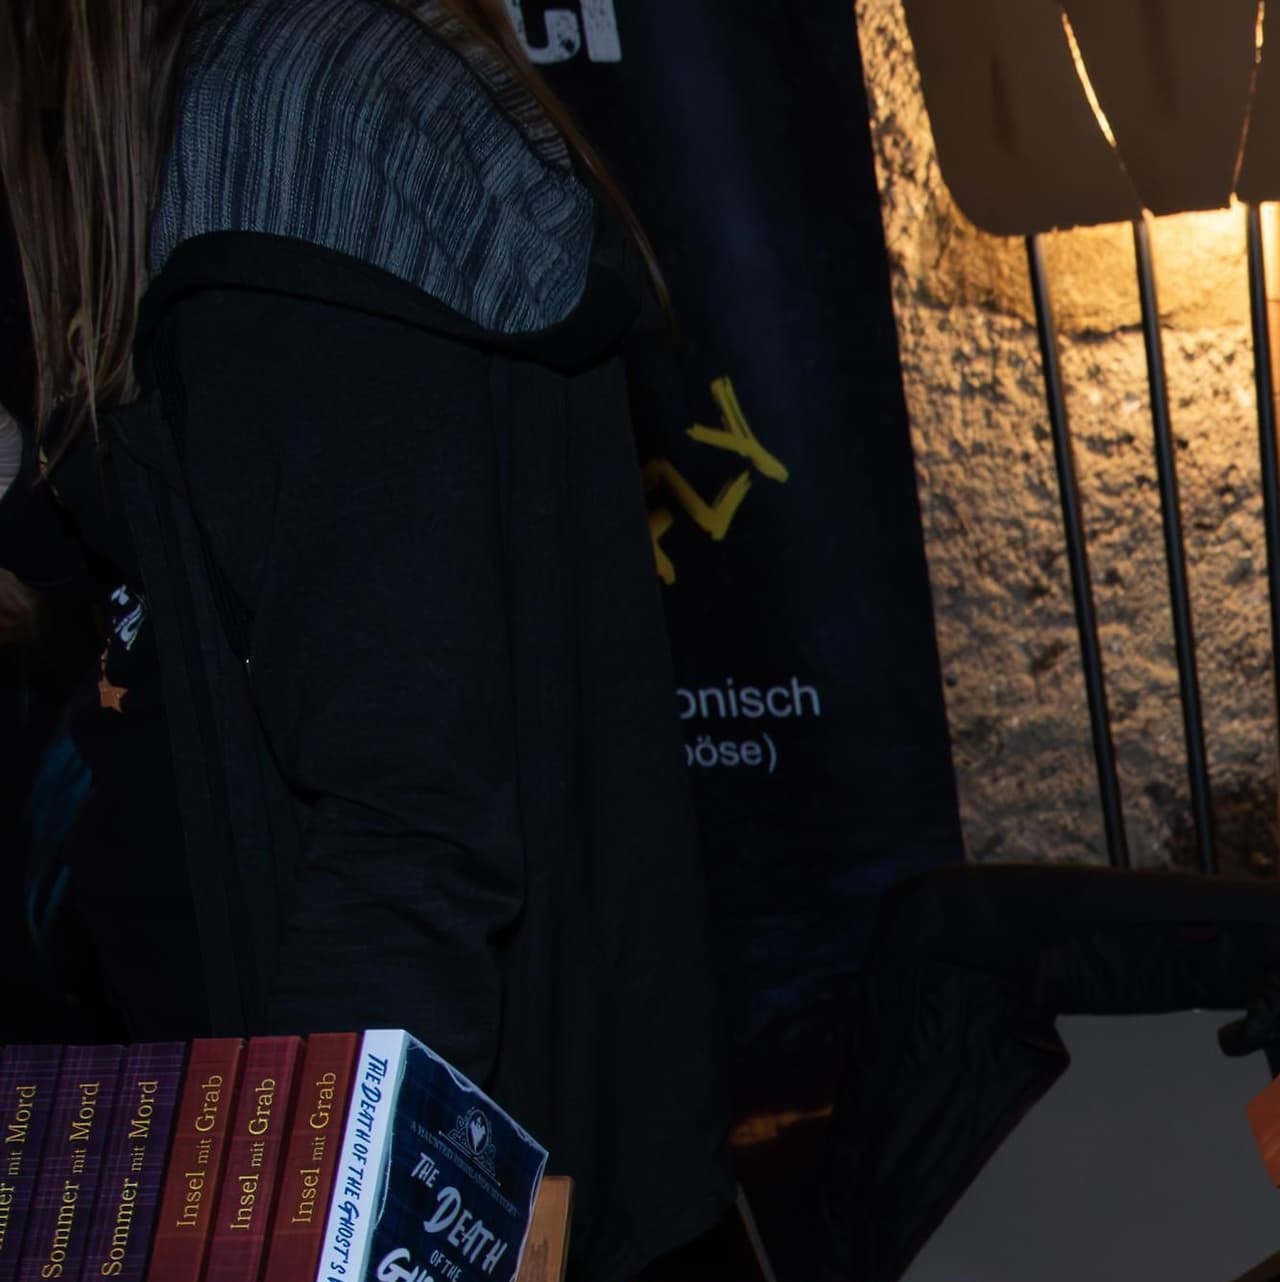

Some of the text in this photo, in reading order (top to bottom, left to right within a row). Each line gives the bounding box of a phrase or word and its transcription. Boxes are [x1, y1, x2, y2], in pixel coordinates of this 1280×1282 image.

[69, 1081, 100, 1142] Mord
[128, 1080, 158, 1139] Mord
[195, 1074, 223, 1132] Grab
[310, 1071, 337, 1129] Grab
[357, 1079, 383, 1141] DEATH
[72, 1147, 87, 1174] mit
[131, 1145, 146, 1172] mit
[196, 1138, 212, 1164] mit
[313, 1135, 325, 1162] mit
[411, 1152, 439, 1188] THE
[177, 1171, 205, 1227] Insel
[293, 1168, 320, 1224] Insel
[41, 1180, 80, 1278] Sommer
[101, 1177, 139, 1276] Sommer
[424, 1187, 508, 1275] DEATH
